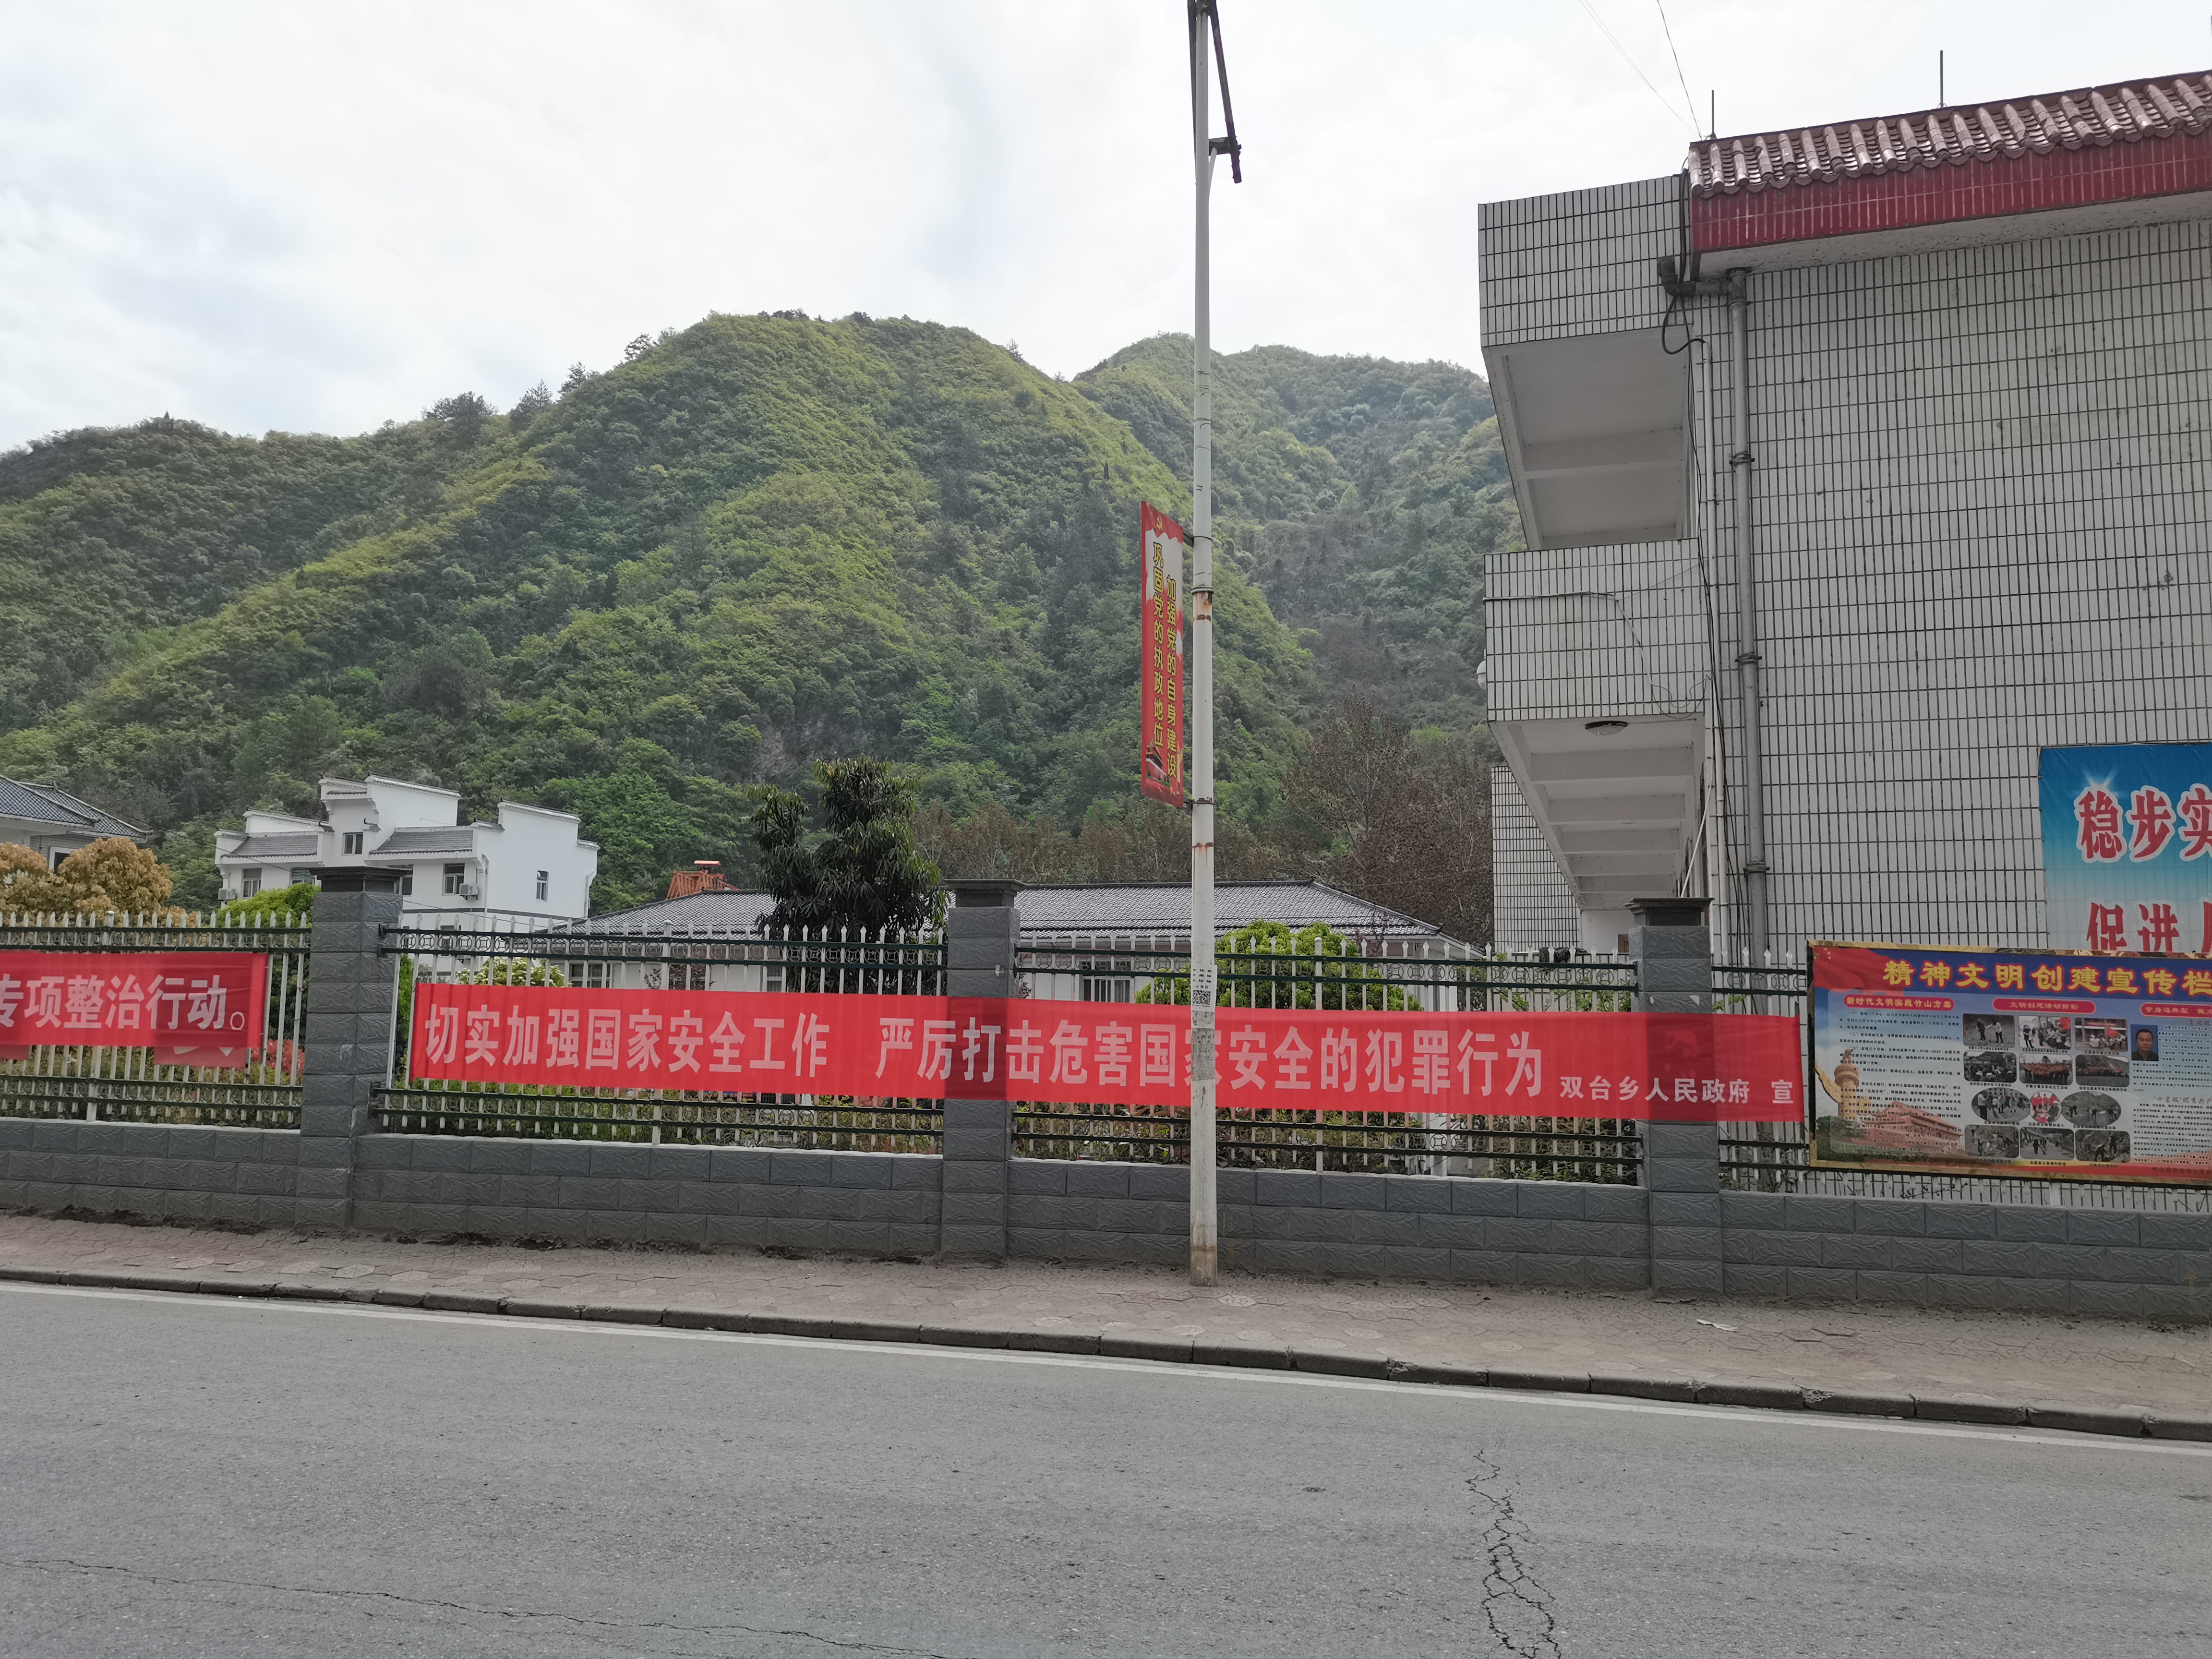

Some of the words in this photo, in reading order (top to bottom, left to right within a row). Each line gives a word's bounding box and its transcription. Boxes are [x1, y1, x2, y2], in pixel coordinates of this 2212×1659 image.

[1153, 542, 1164, 747] 巩固党的执政地位
[1166, 575, 1177, 778] 加强党的自身建设
[2077, 786, 2212, 860] 稳步实
[2086, 902, 2212, 953] 促进
[1846, 997, 1953, 1009] 新时代文明实践竹山方案
[1883, 960, 2212, 996] 精神文明创建宣传栏
[424, 1003, 830, 1078] 切实加强国家安全工作
[1559, 1075, 1750, 1105] 双台乡人民政府
[1770, 1078, 1794, 1105] 宣
